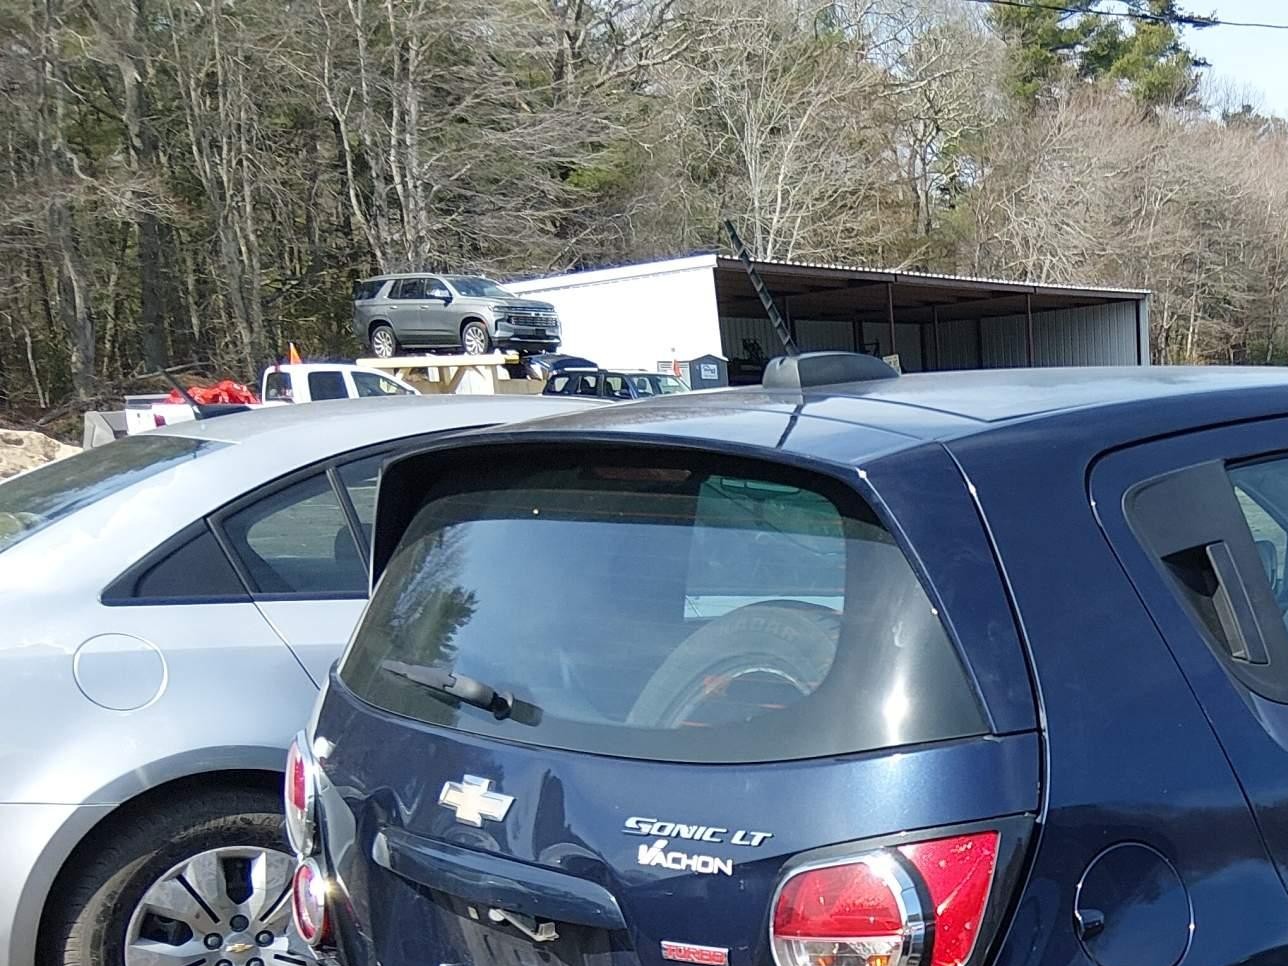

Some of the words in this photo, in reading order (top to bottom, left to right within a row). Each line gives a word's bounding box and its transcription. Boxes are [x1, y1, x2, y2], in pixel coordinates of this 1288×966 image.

[621, 816, 728, 843] SONIC
[730, 829, 774, 847] LT
[637, 839, 733, 876] VACHON
[661, 942, 727, 966] TURBO
